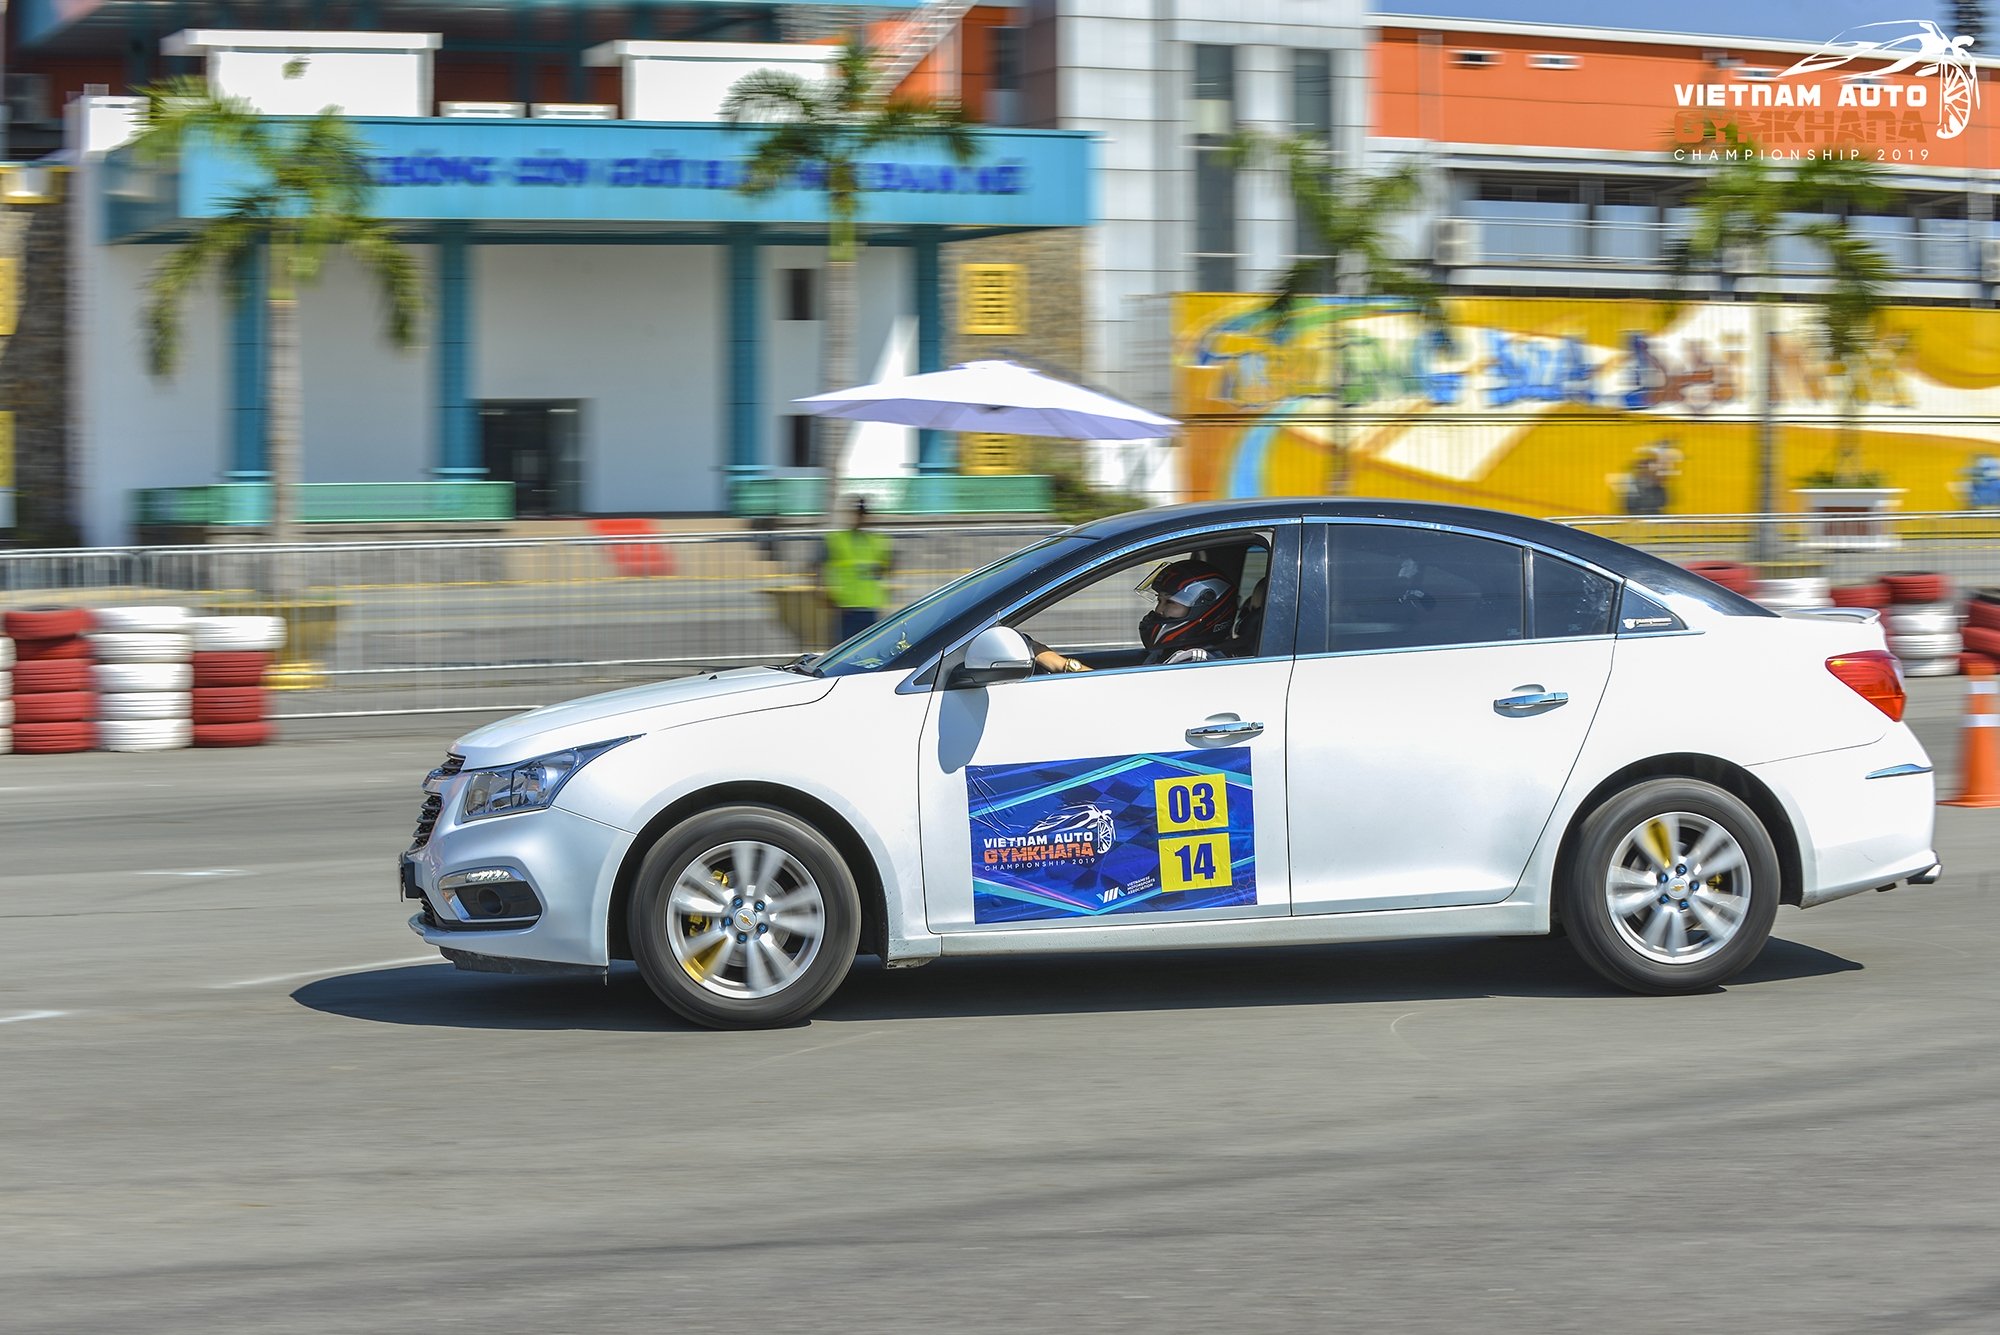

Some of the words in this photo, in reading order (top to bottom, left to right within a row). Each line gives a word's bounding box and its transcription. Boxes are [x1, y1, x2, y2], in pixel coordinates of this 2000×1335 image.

[1168, 782, 1216, 824] 03
[983, 835, 1048, 849] VIETNAM
[1054, 831, 1094, 844] AUTO
[983, 842, 1095, 864] GYMKHANA
[1174, 842, 1216, 882] 14
[984, 859, 1066, 872] CHAMPIONSHIP
[1072, 857, 1096, 865] 2019
